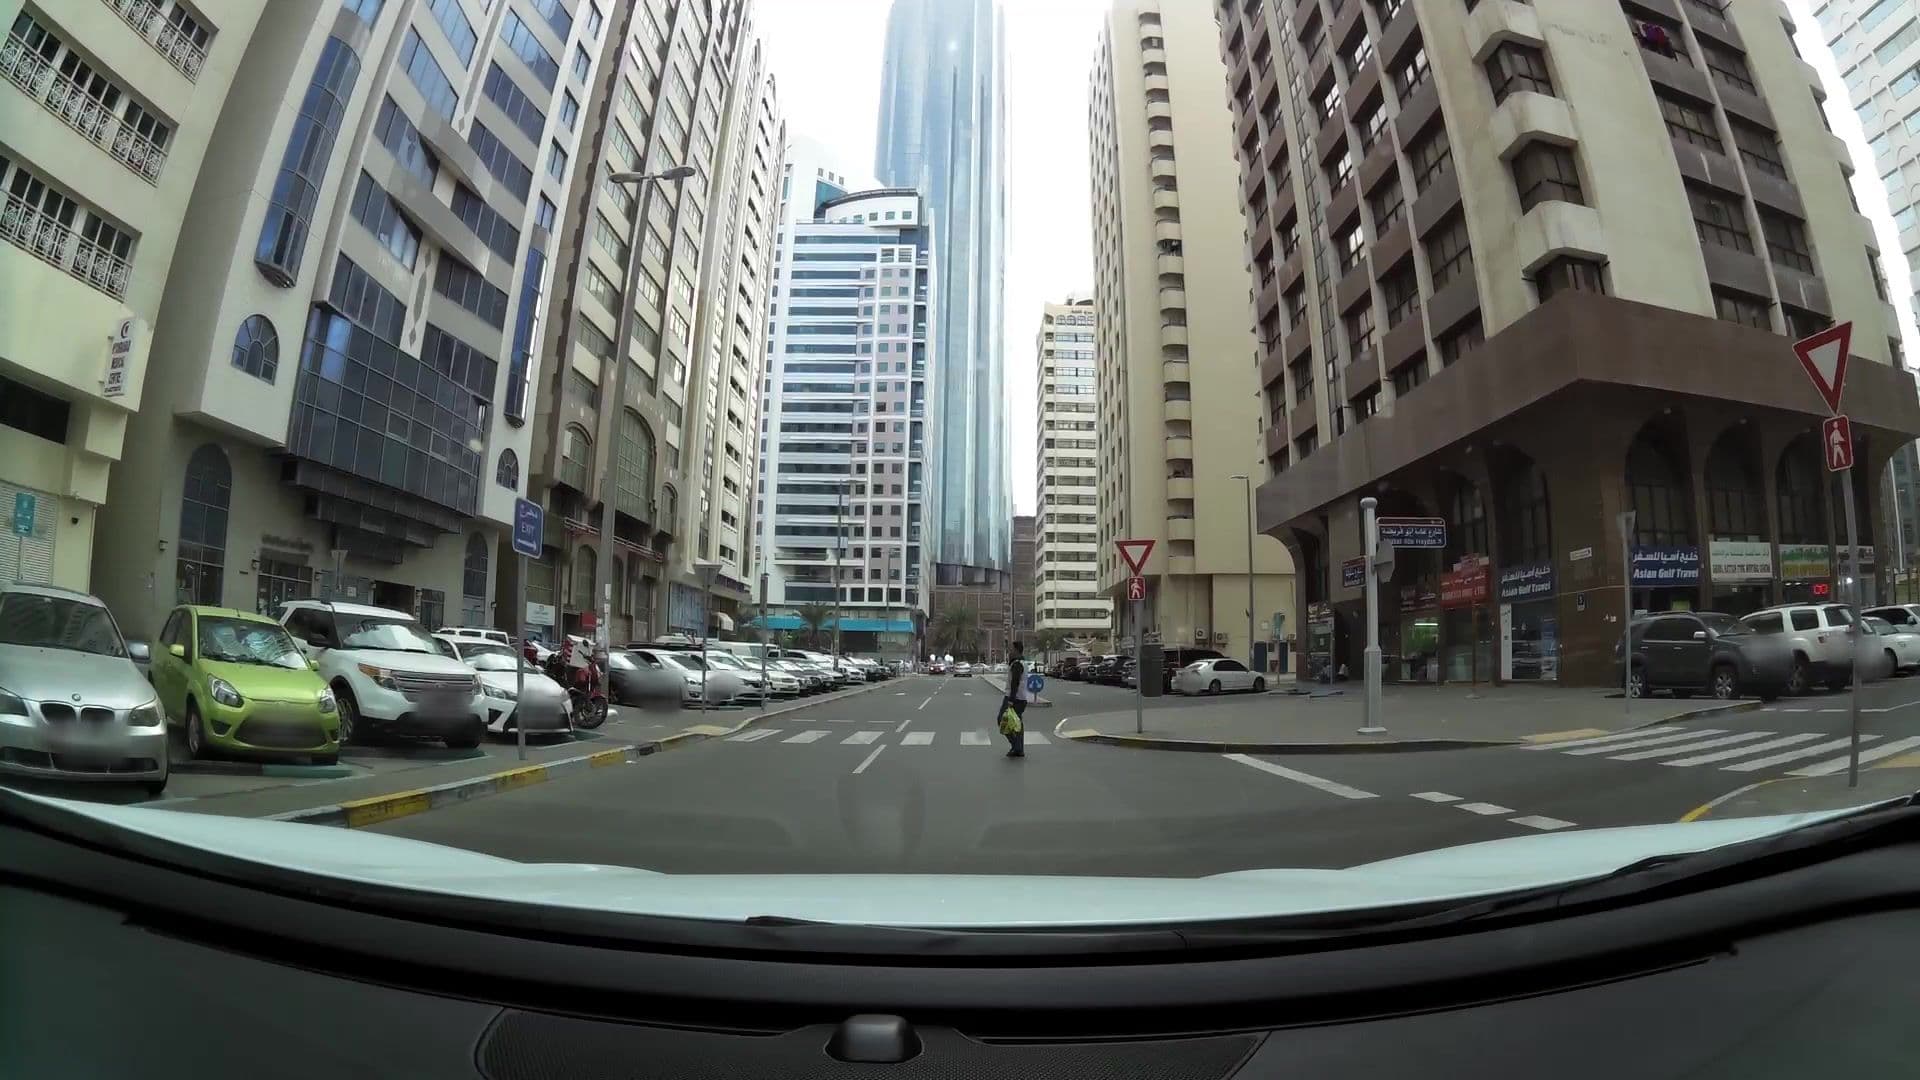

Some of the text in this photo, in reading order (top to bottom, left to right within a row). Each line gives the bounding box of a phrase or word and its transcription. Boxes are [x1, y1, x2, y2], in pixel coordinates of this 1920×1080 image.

[521, 521, 537, 539] EXIT
[1679, 546, 1699, 564] خليج
[1633, 567, 1658, 579] Asian
[1658, 567, 1676, 579] Gulf
[1676, 567, 1699, 579] Travel
[1501, 581, 1551, 598] Asian Gulf Travel
